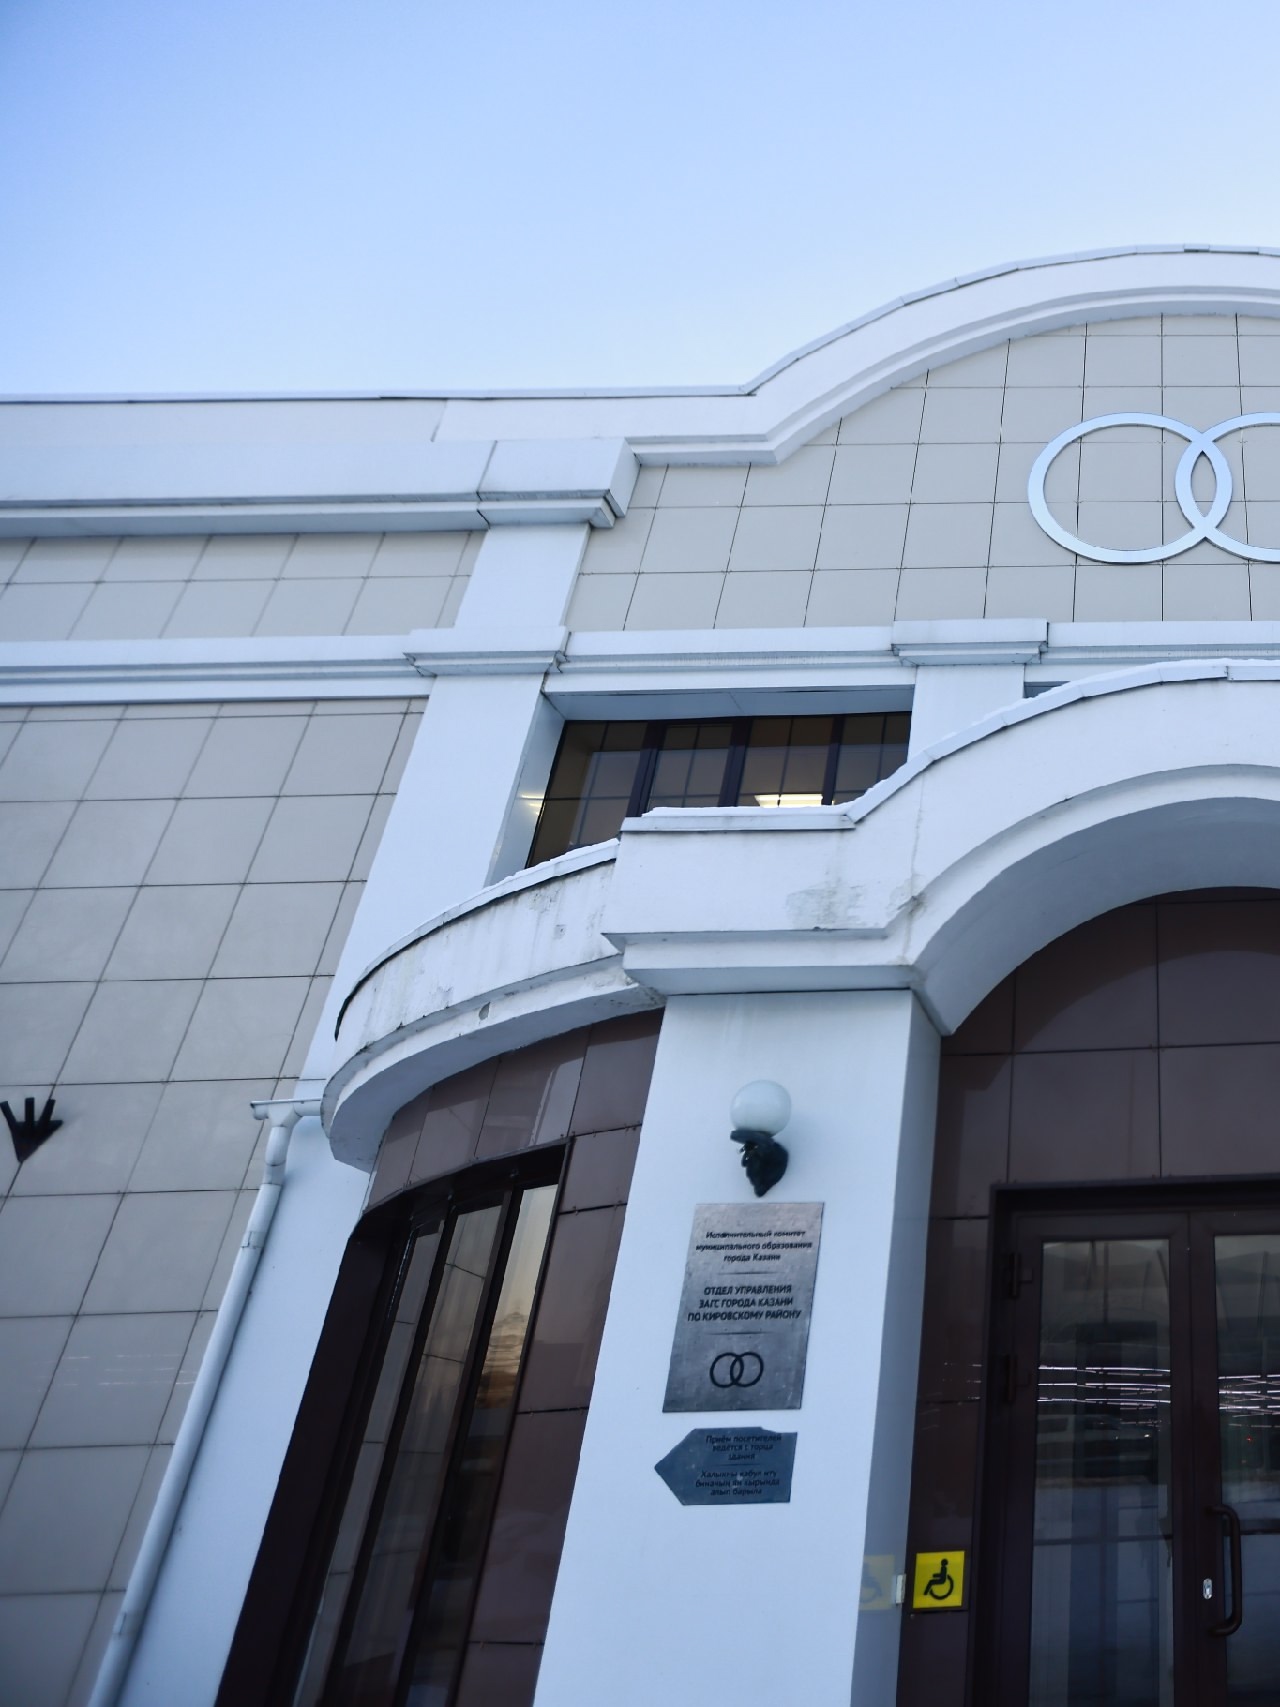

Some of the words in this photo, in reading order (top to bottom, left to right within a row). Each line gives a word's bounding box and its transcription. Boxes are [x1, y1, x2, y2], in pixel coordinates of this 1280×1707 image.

[774, 1230, 806, 1238] комитет
[696, 1242, 760, 1252] муниципального
[762, 1241, 812, 1251] образования
[723, 1254, 751, 1263] города
[752, 1253, 781, 1262] Казани
[704, 1286, 733, 1296] ОТДЕЛ
[735, 1285, 792, 1295] УПРАВЛЕНИЯ
[699, 1299, 720, 1309] ЗАГС
[721, 1298, 756, 1308] ГОРОДА
[758, 1297, 793, 1307] КАЗАНИ
[688, 1312, 701, 1321] ПО
[702, 1311, 764, 1321] КИРОВСКОМУ
[765, 1310, 802, 1320] РАЙОНУ
